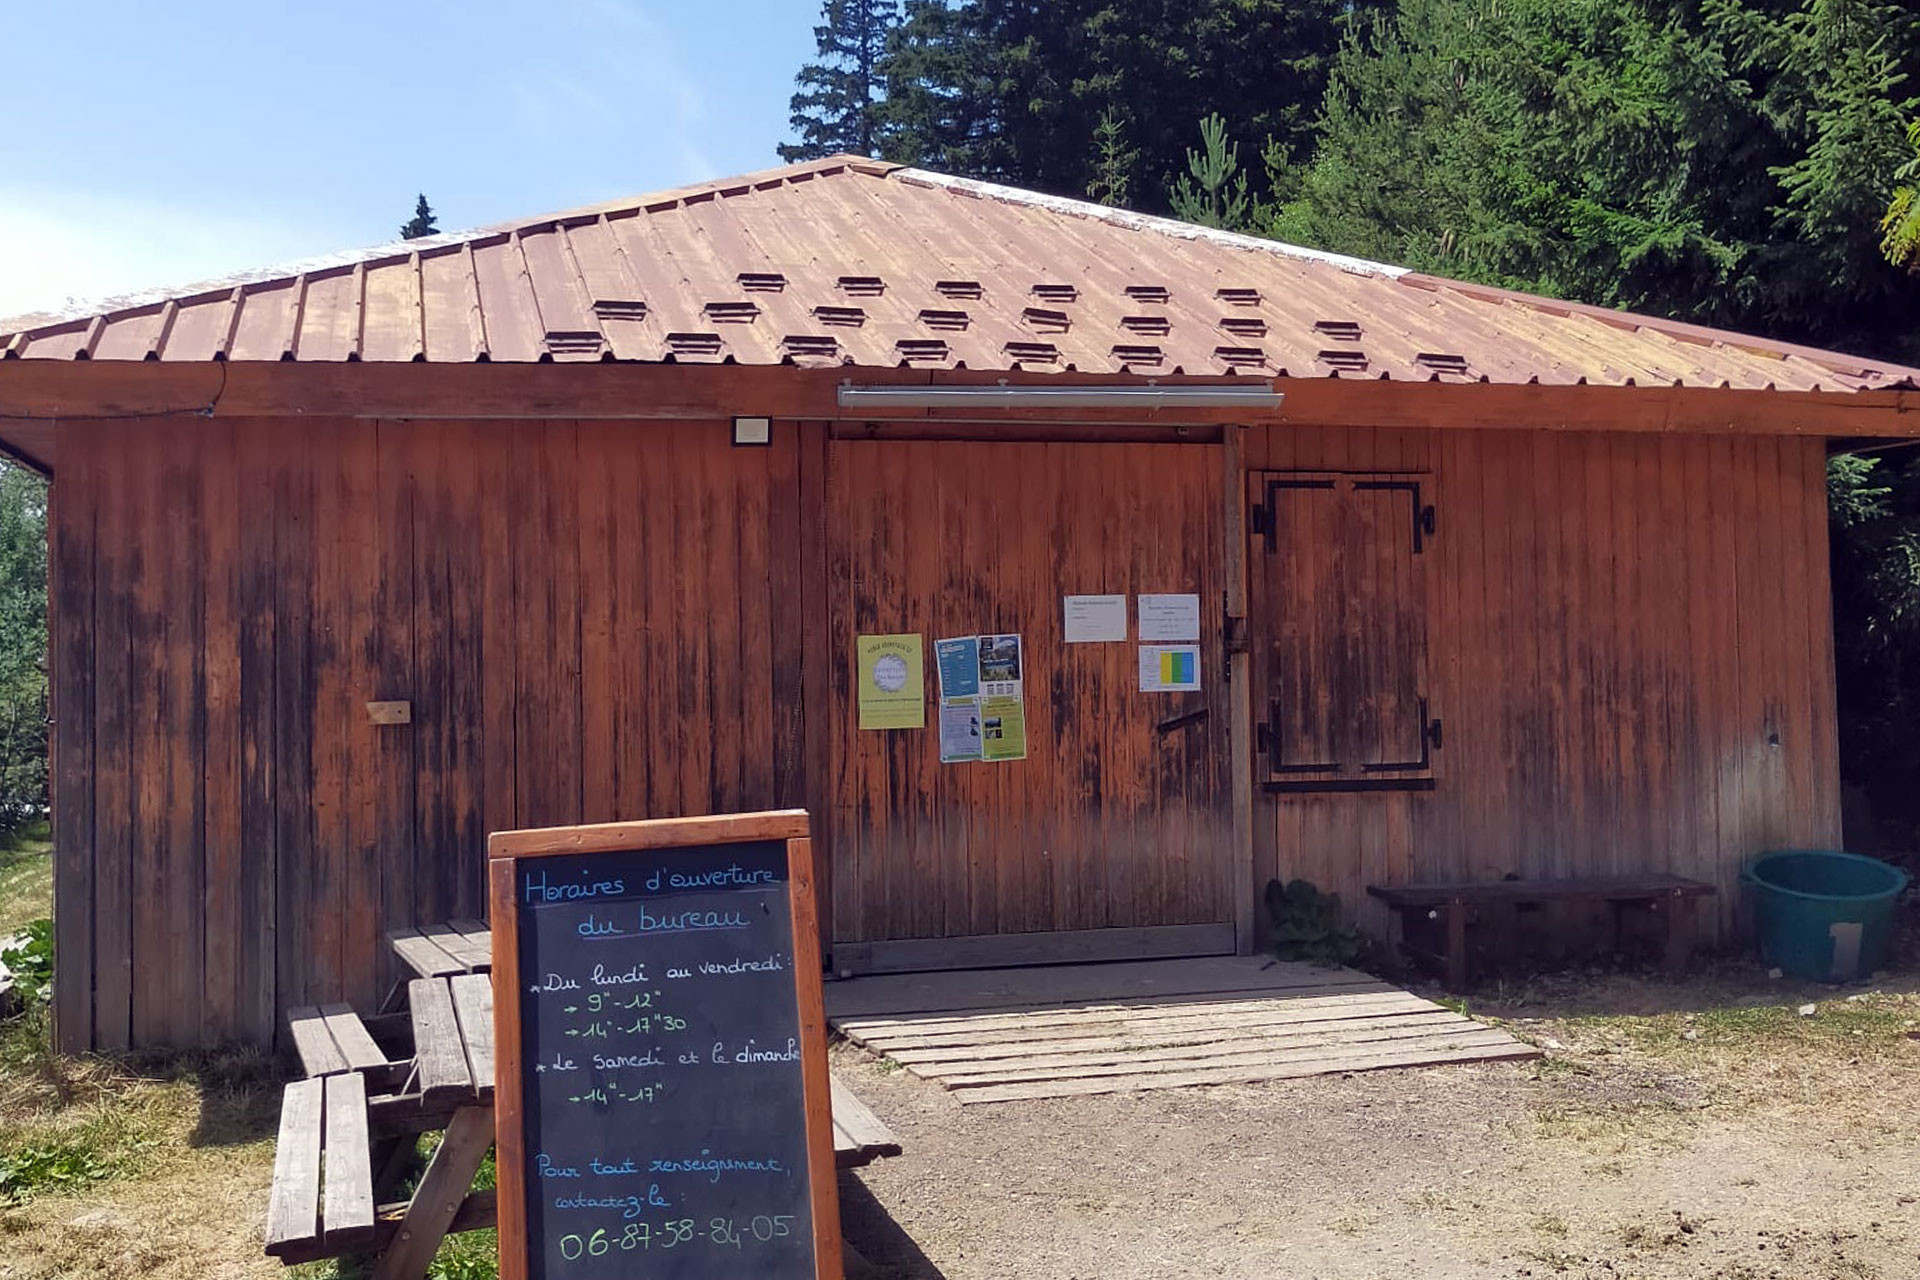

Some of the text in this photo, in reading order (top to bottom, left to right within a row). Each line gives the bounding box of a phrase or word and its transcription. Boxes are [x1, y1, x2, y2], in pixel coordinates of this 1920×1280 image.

[526, 864, 781, 903] Horaires d'ouverture
[578, 905, 752, 935] du bureau
[544, 973, 580, 991] Du
[591, 963, 648, 985] lundi
[666, 967, 692, 979] au
[553, 1053, 578, 1070] Le
[679, 1049, 698, 1064] et
[713, 1042, 734, 1063] le
[736, 1038, 801, 1063] dimanche
[535, 1153, 581, 1178] Pour
[590, 1157, 638, 1174] tout
